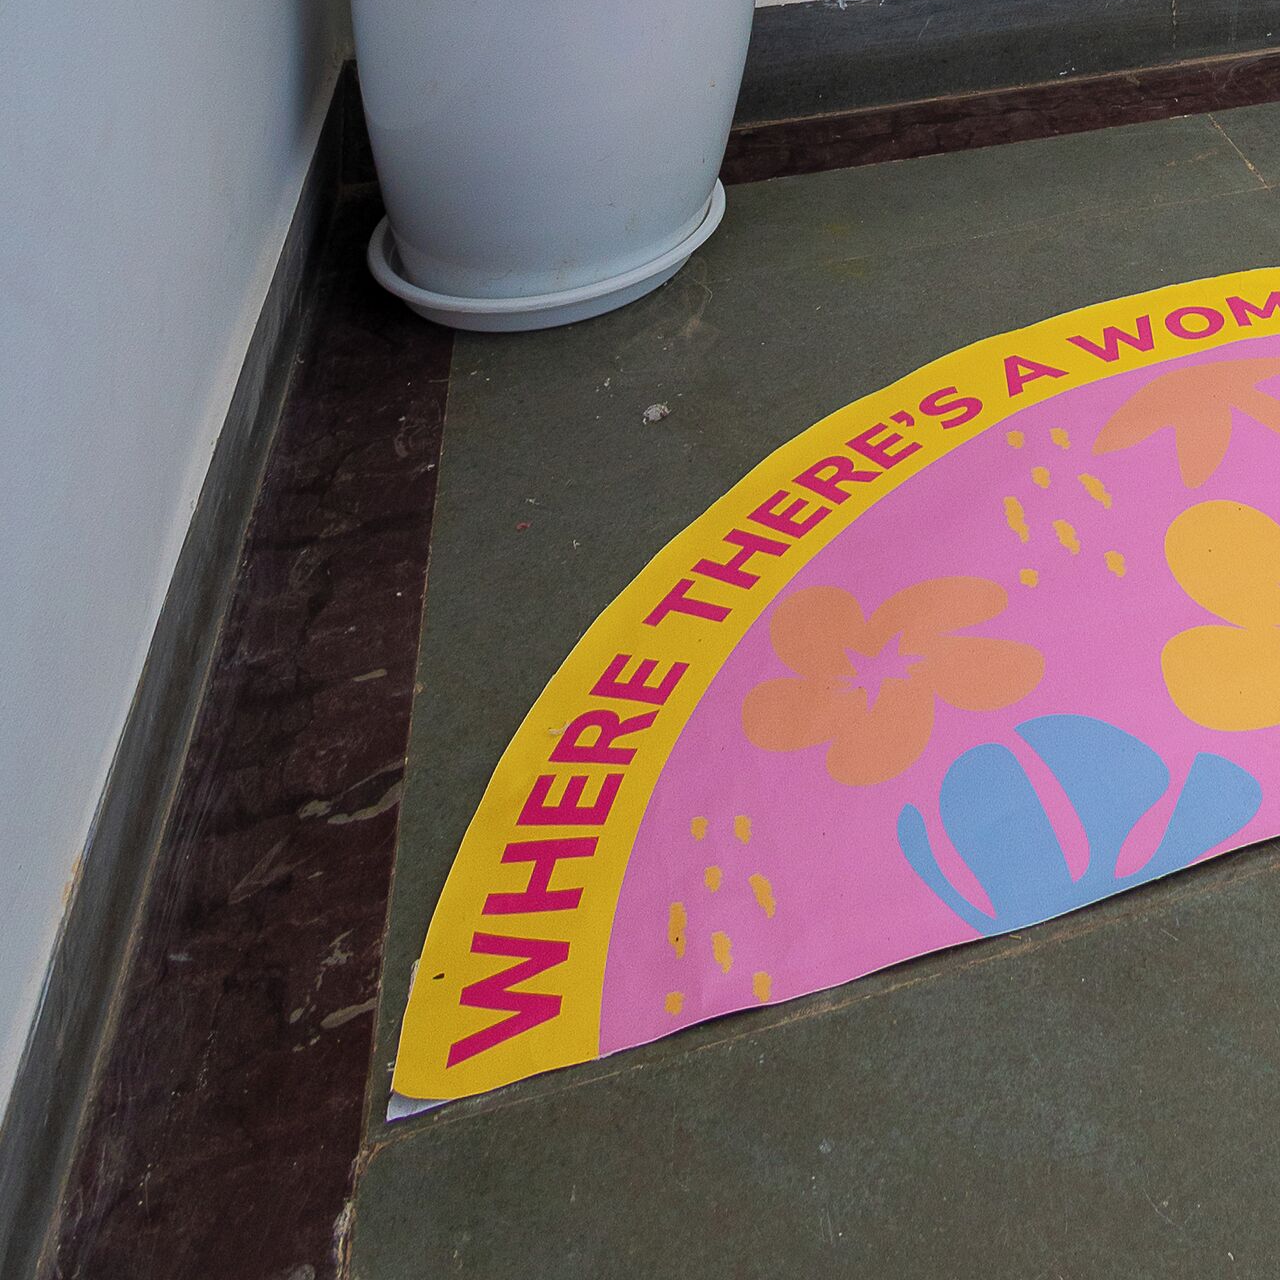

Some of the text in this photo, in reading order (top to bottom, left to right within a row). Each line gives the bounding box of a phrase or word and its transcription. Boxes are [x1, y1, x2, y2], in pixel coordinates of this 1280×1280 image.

[447, 654, 689, 1068] WHERE
[644, 387, 983, 627] THERE'S
[1004, 355, 1067, 397] A
